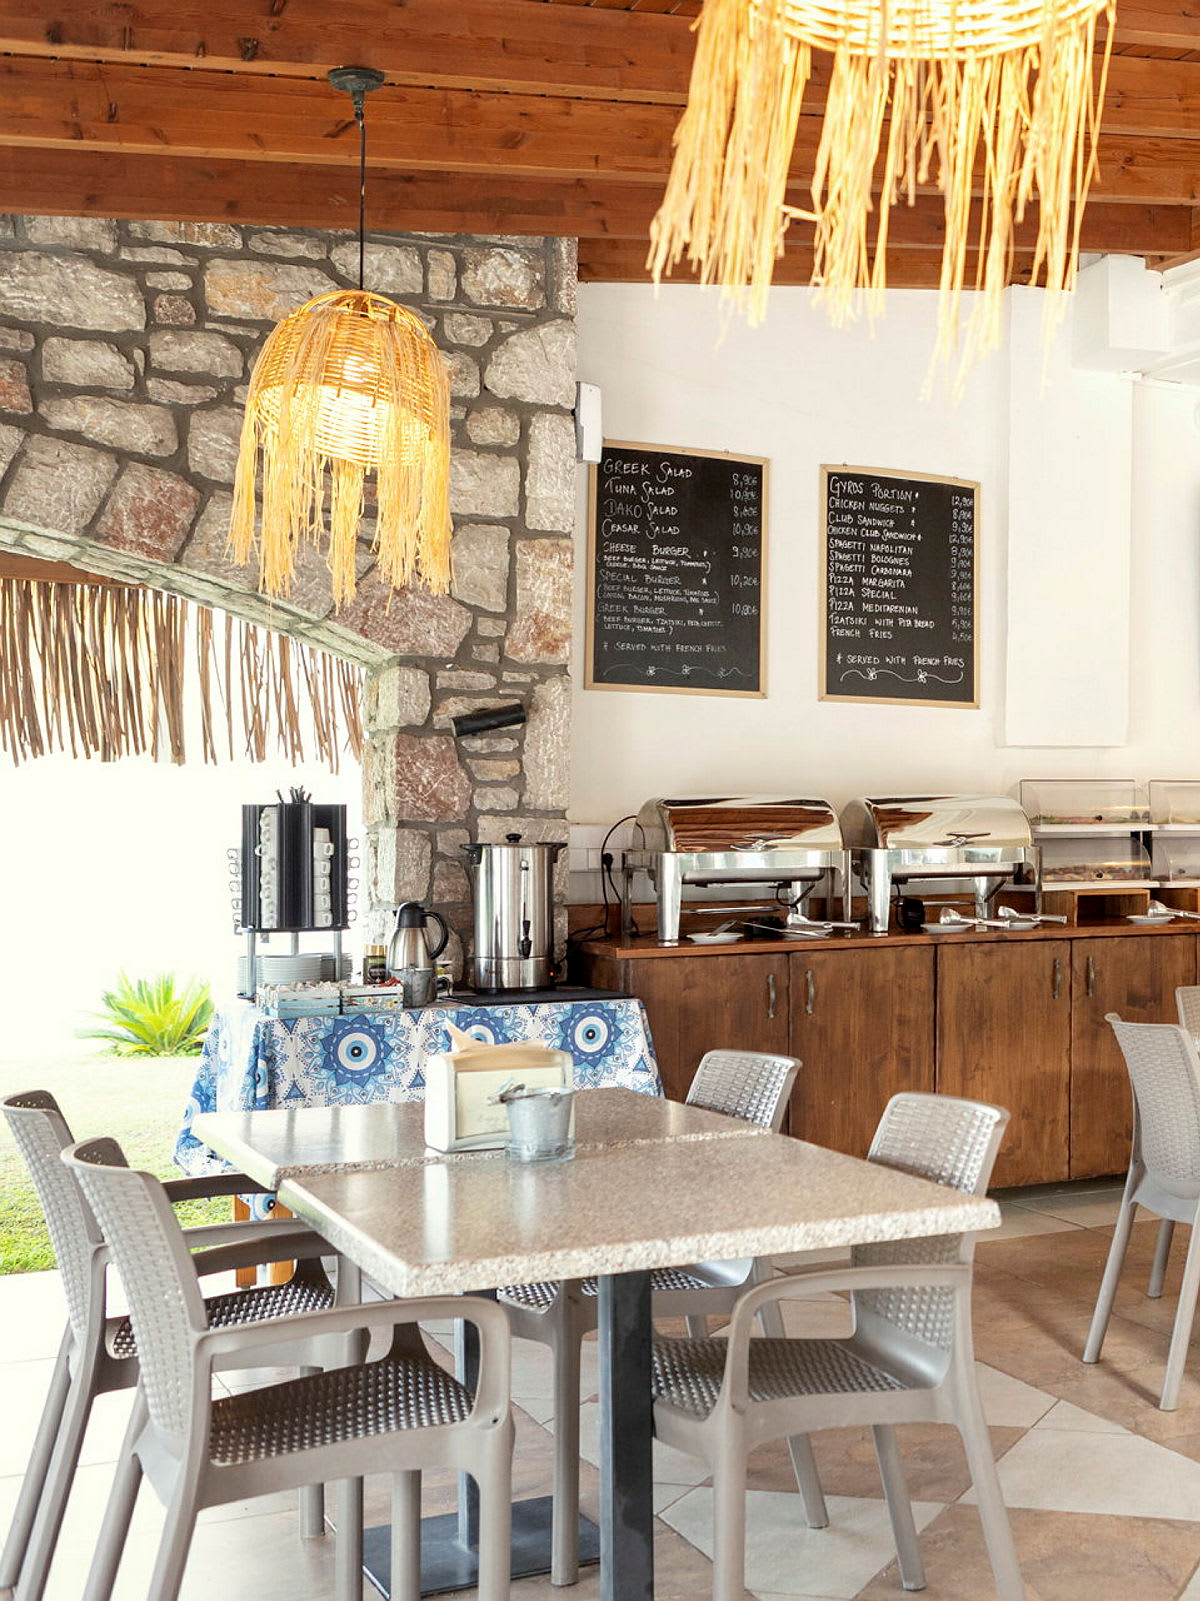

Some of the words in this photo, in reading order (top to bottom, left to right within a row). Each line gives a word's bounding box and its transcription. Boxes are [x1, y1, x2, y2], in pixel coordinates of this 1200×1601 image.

[603, 459, 650, 475] GREEK
[656, 461, 693, 483] SALAD
[604, 476, 637, 495] TUNA
[641, 481, 675, 503] SALAD
[829, 476, 864, 498] GYROS
[871, 482, 912, 501] PORTION
[647, 502, 678, 520] SALAD
[828, 497, 865, 511] CHICKEN
[869, 501, 905, 514] NUGGETS
[828, 511, 854, 524] CLUB
[857, 514, 895, 527] SANDWICH
[646, 521, 680, 539] SALAD
[828, 525, 858, 536] CHICKEN
[860, 527, 880, 538] CLUB
[603, 541, 637, 554] CHEESE
[652, 544, 691, 559] BURGER
[828, 538, 865, 551] SPAGETTI
[870, 540, 914, 555] NAPOLITAN
[828, 550, 865, 562] SPAGETTI
[828, 562, 865, 574] SPAGETTI
[871, 565, 912, 577] CARBONARA
[829, 573, 854, 586] PIZZA
[862, 577, 906, 588] MARGARITA
[829, 585, 855, 597] PIZZA
[861, 587, 897, 600] SPECIAL
[829, 598, 854, 611] PIZZA
[875, 618, 894, 628] WITH
[830, 626, 861, 638] FRENCH
[868, 628, 893, 639] FRIES
[847, 654, 880, 665] SERVED
[886, 655, 906, 665] WITH
[912, 655, 940, 666] FRENCH
[943, 656, 965, 668] FRIES
